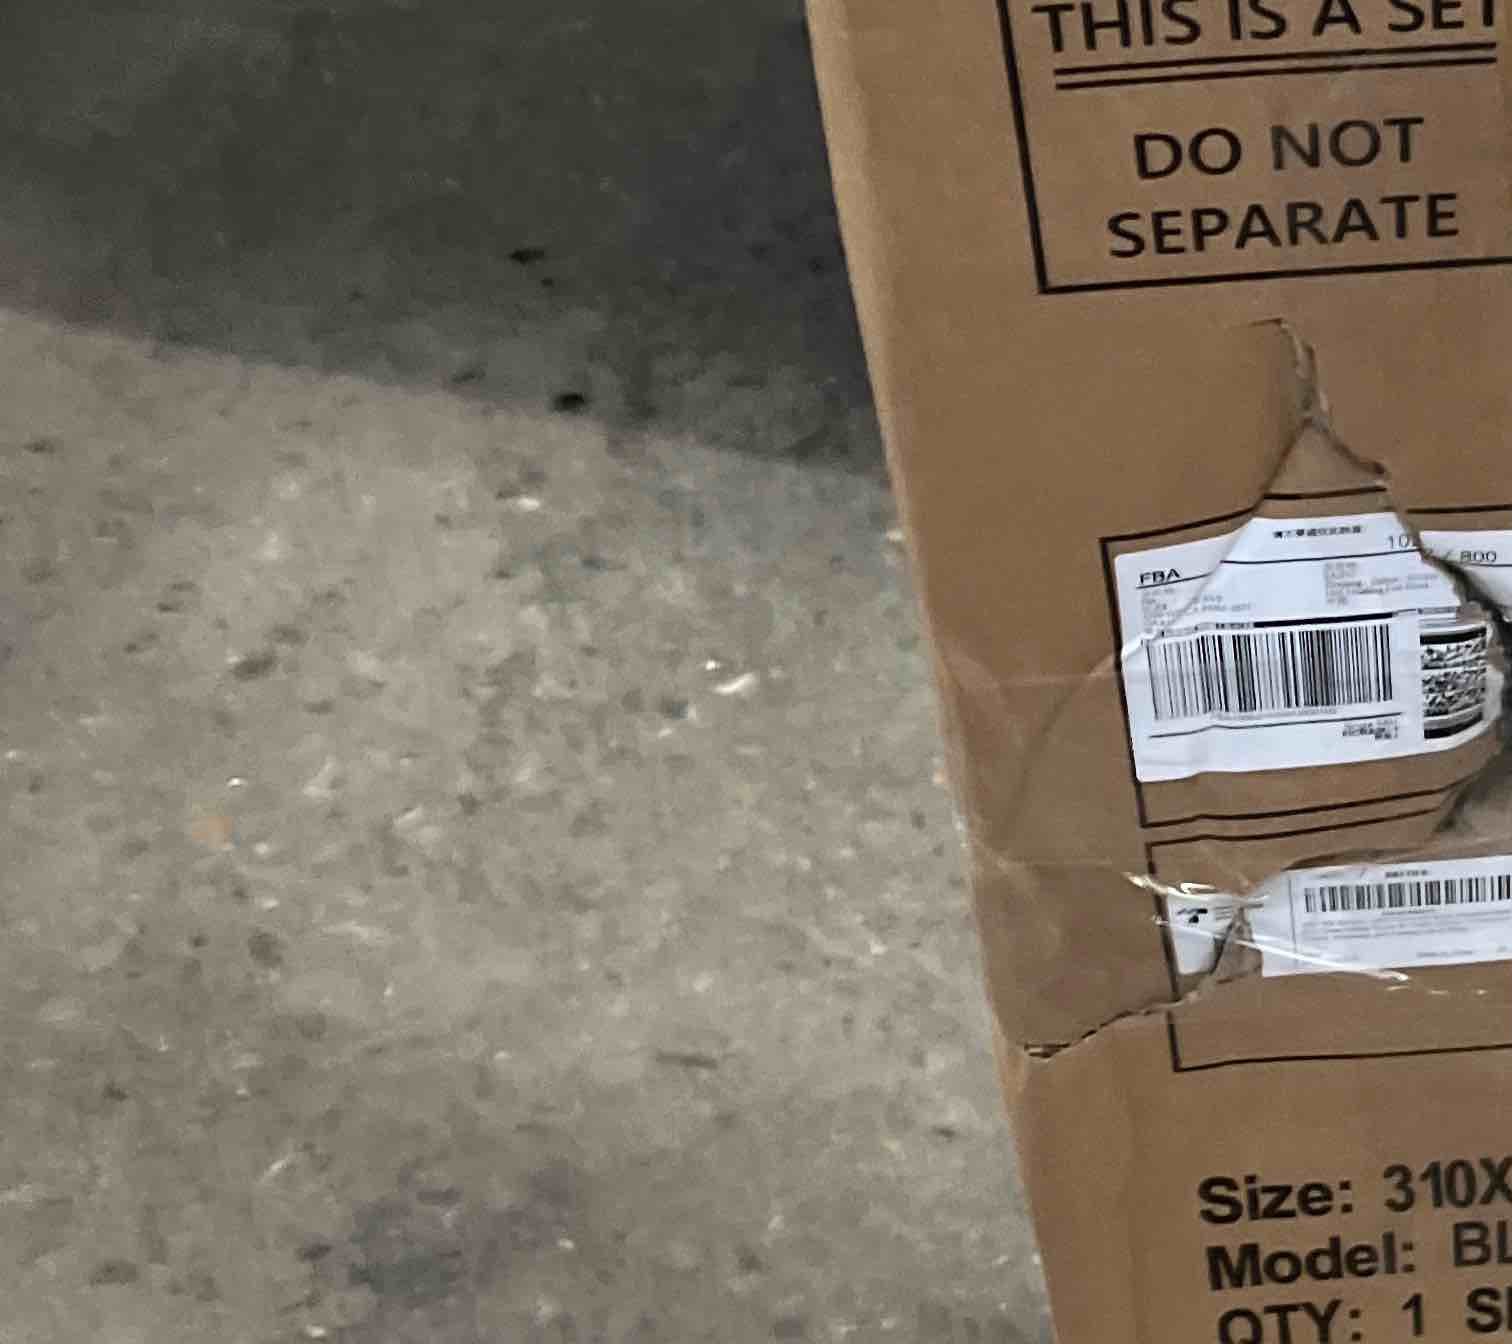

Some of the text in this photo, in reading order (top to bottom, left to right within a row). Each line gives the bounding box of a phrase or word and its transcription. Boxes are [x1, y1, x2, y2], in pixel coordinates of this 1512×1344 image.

[1133, 116, 1425, 180] DO NOT
[1107, 192, 1460, 258] SEPARATE
[1139, 568, 1181, 585] FBA
[1197, 1173, 1354, 1226] Size:
[1206, 1231, 1416, 1292] Model:
[1401, 1293, 1426, 1338] 1
